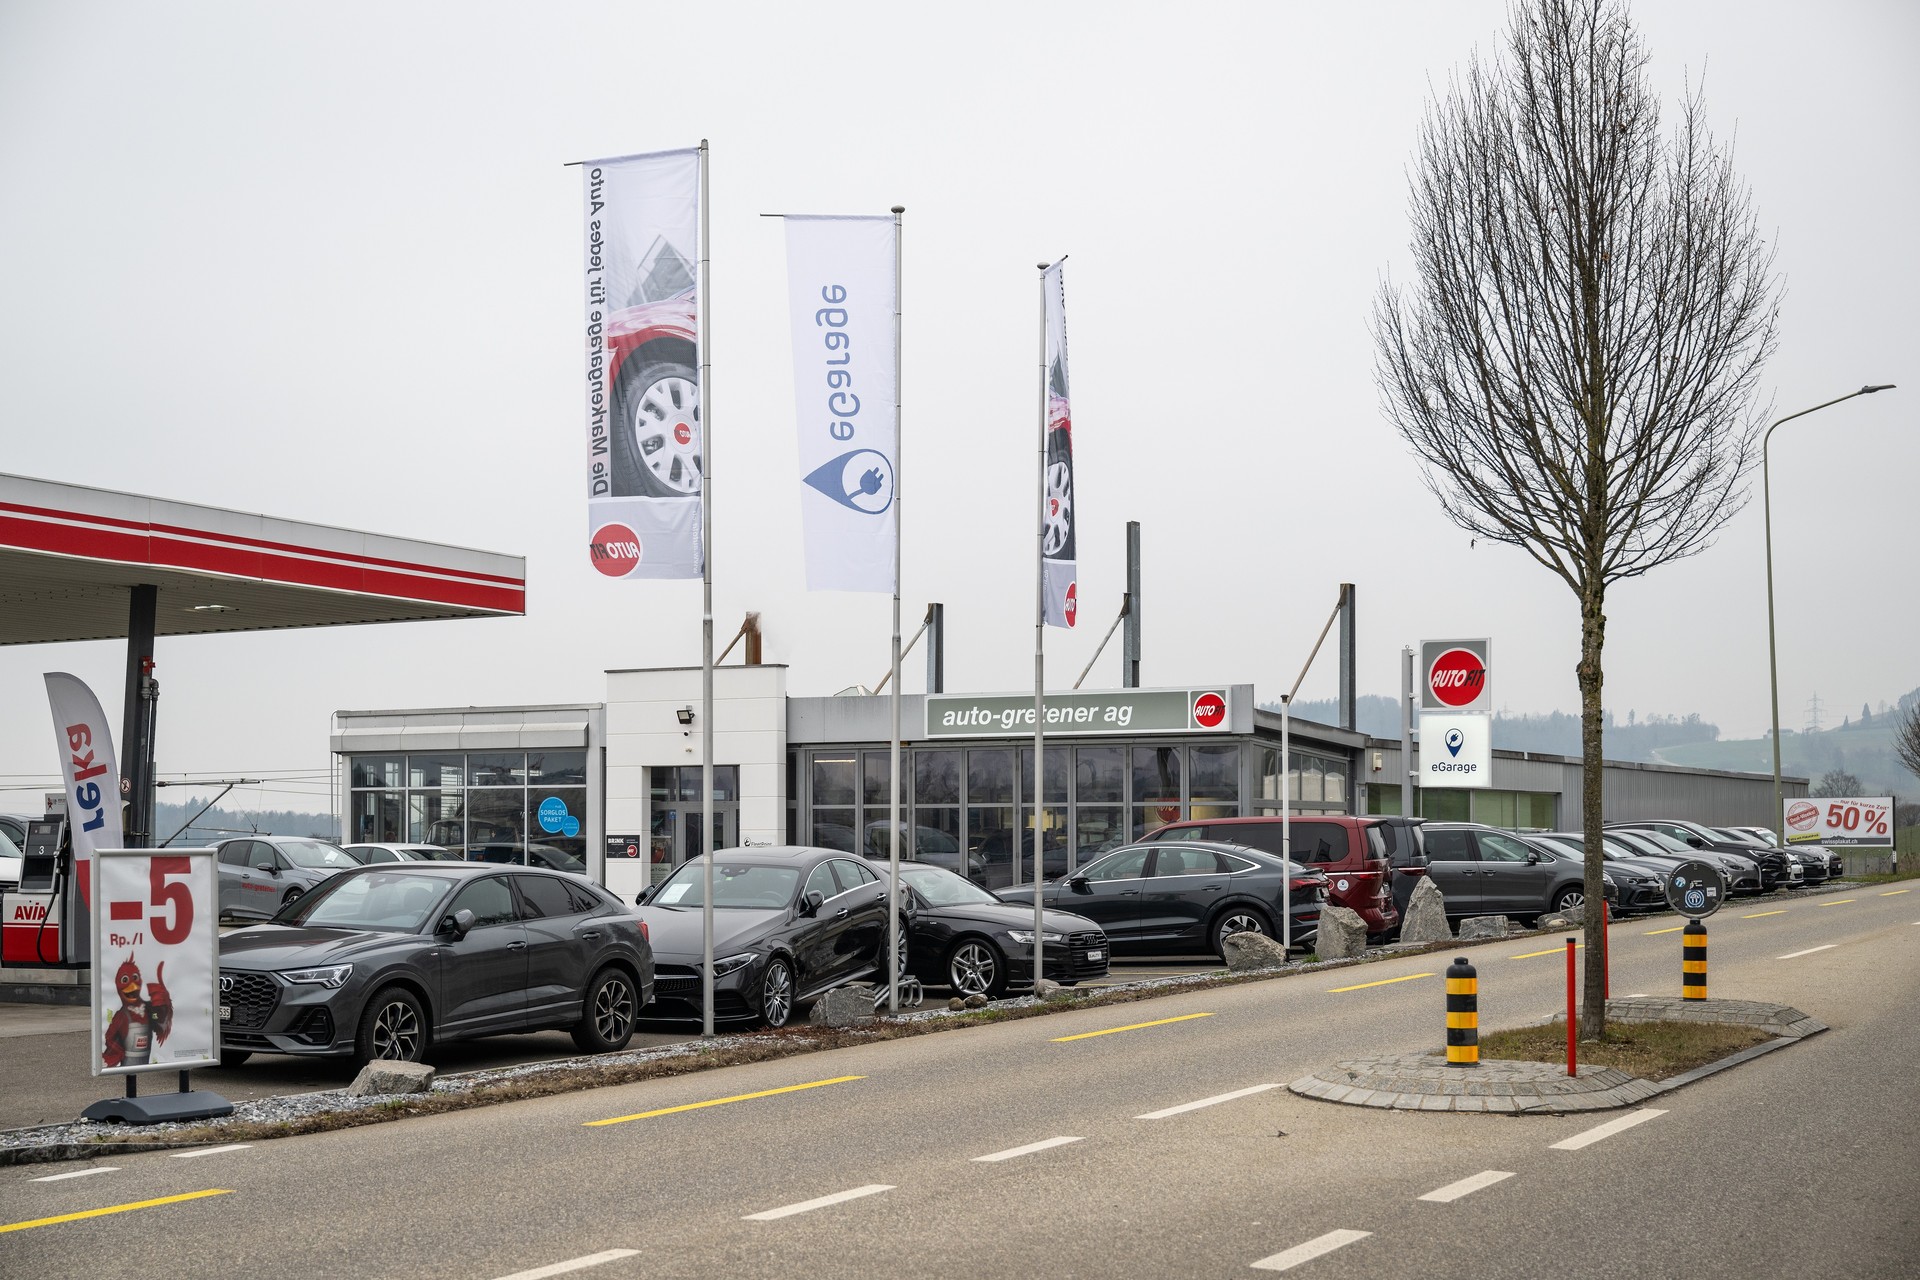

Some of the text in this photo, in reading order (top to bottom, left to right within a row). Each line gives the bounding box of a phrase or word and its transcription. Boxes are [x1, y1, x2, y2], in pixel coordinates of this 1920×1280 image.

[1432, 669, 1487, 688] AUTOFIT
[1103, 704, 1133, 727] ag
[1194, 704, 1226, 717] AUTOFIT
[1431, 761, 1477, 774] eGarage
[1826, 803, 1888, 835] 50 %
[38, 845, 45, 855] 3
[110, 856, 194, 945] -5
